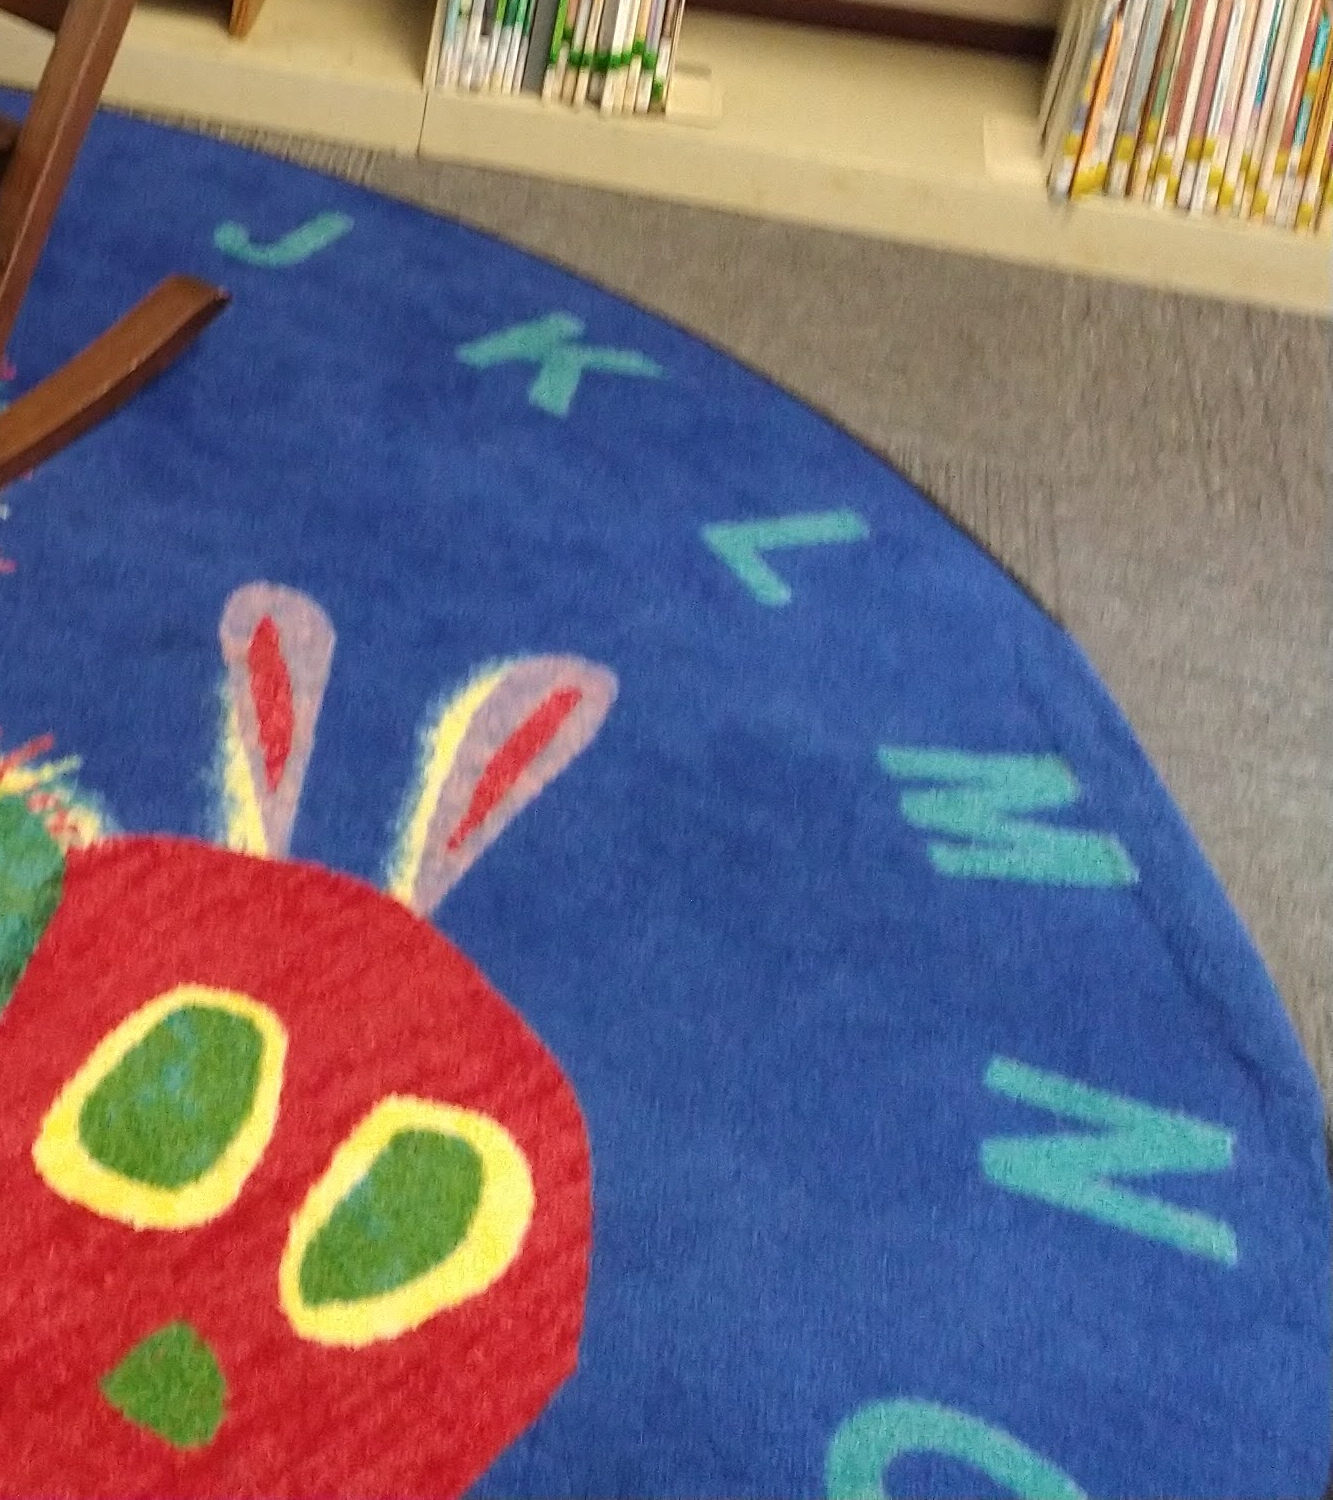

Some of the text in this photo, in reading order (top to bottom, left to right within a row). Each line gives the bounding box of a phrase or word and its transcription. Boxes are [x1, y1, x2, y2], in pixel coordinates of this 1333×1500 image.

[213, 211, 353, 266] J
[456, 312, 663, 417] K
[702, 509, 869, 606] L
[877, 745, 1139, 888] M
[980, 1055, 1239, 1268] N
